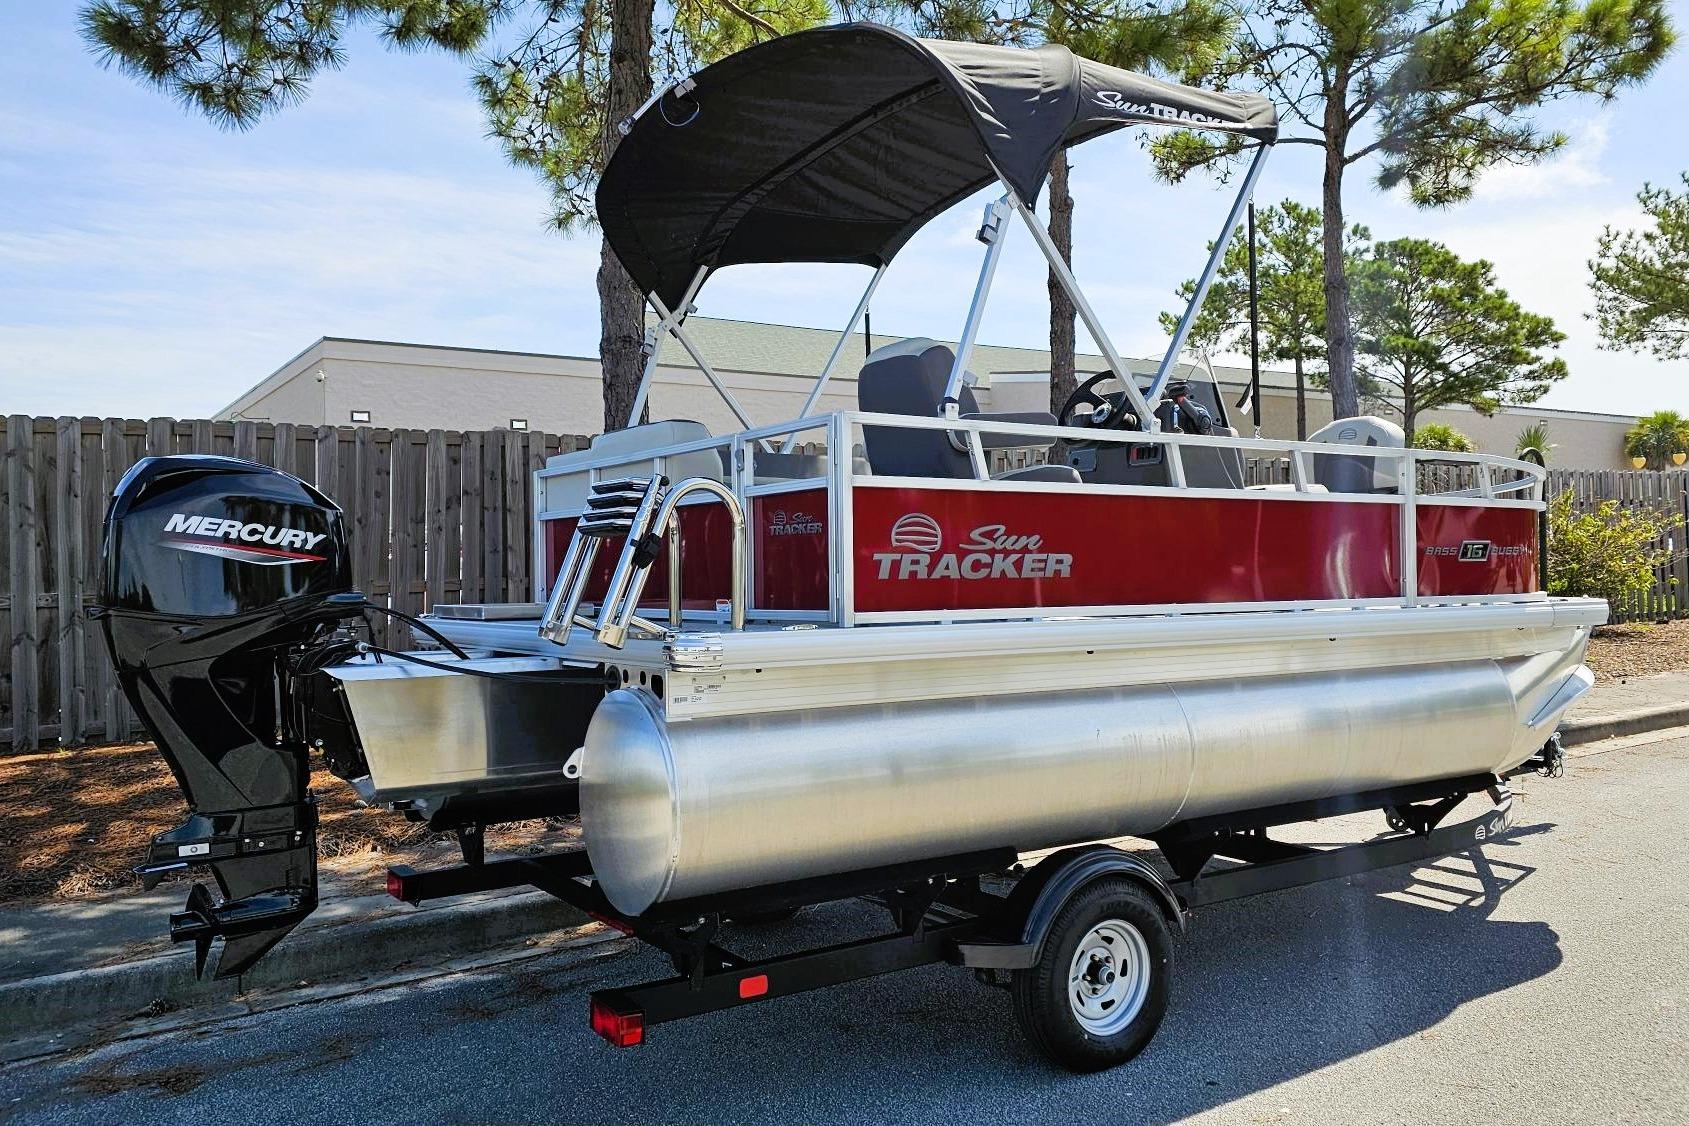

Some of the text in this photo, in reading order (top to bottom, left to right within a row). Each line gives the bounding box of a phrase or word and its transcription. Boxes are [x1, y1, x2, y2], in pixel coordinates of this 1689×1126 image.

[1091, 91, 1150, 114] Sun
[163, 513, 328, 550] MERCURY
[769, 522, 823, 536] TRACKER
[958, 524, 1044, 550] Sun
[1425, 546, 1458, 556] BASS
[872, 552, 1074, 580] TRACKER
